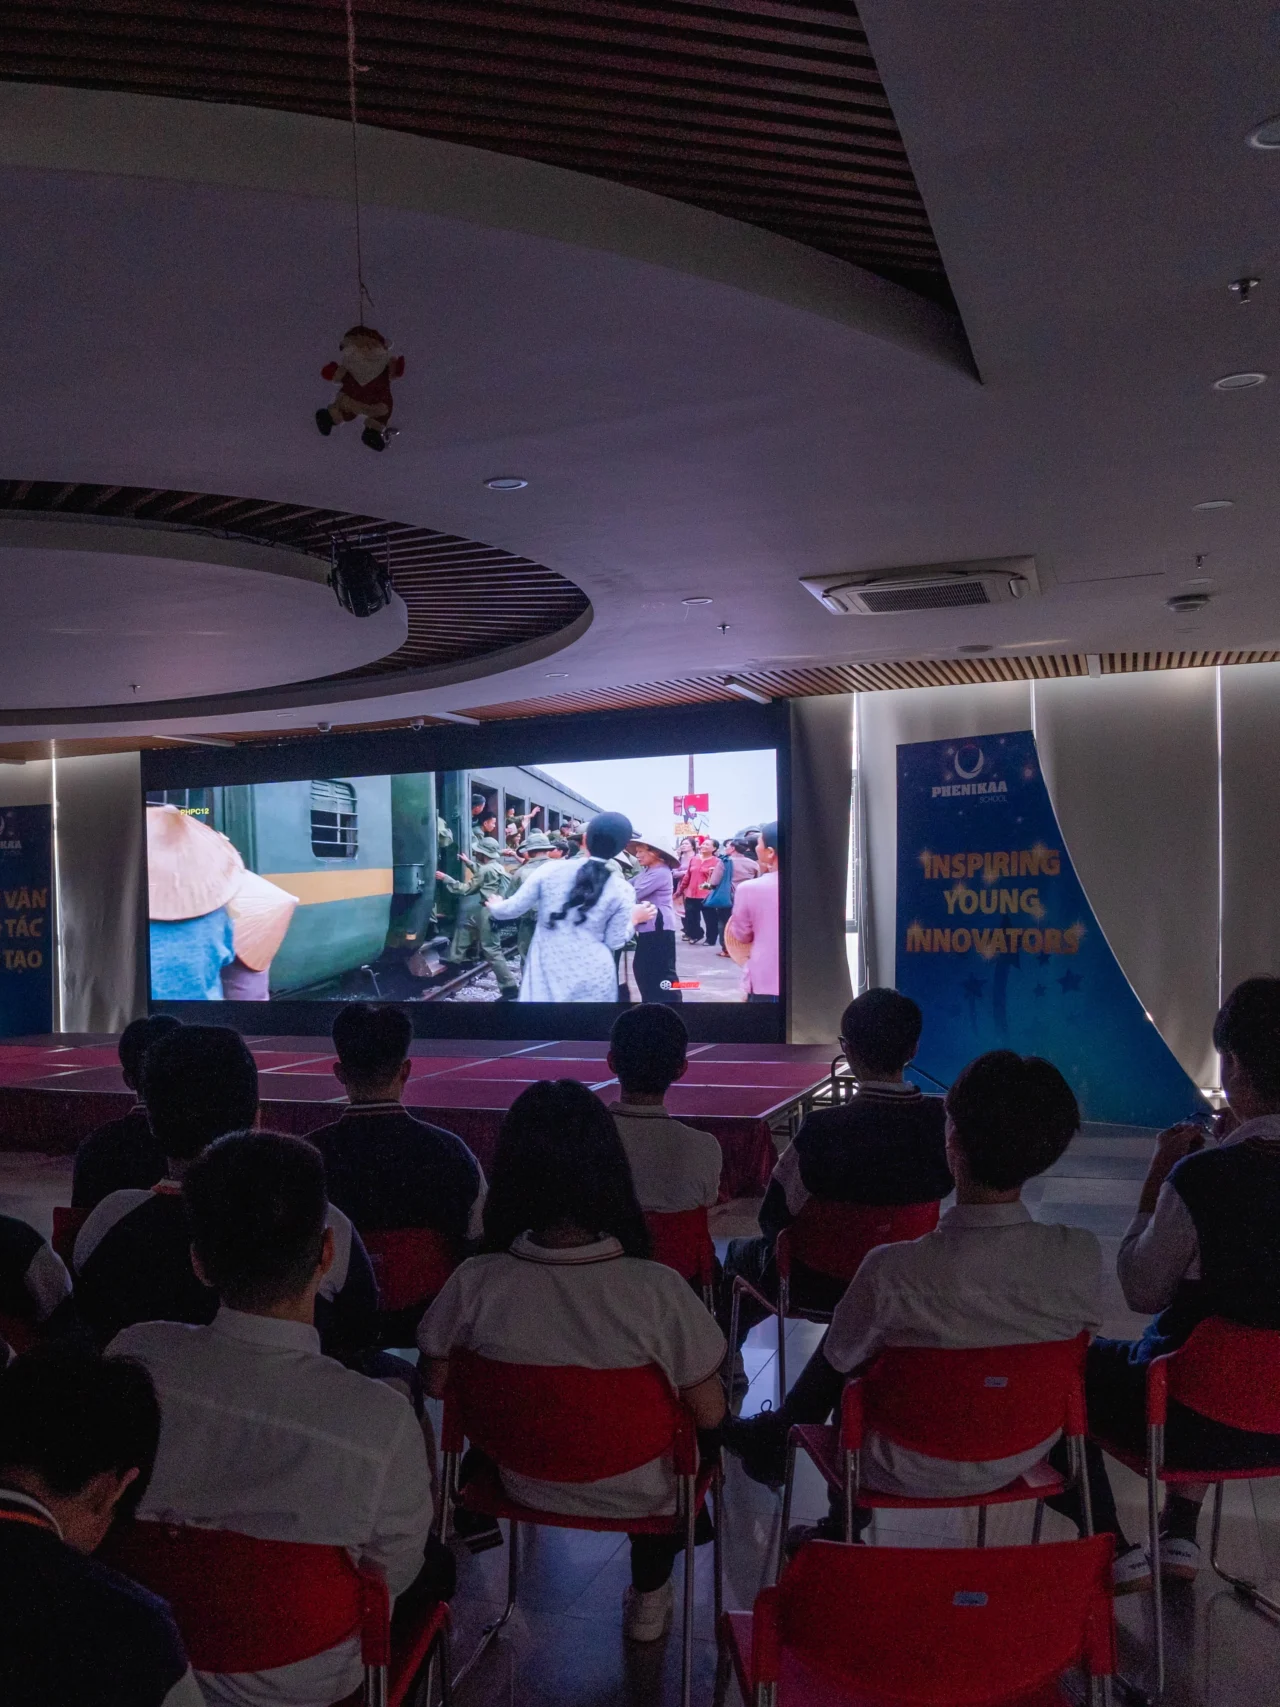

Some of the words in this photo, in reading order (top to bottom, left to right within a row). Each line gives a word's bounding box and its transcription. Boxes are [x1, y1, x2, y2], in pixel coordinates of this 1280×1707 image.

[931, 780, 1008, 798] PHENIKAA
[979, 795, 1007, 804] SCHOOL
[923, 850, 1061, 879] INSPIRING
[943, 887, 1042, 915] YOUNG
[906, 926, 1081, 954] INNOVATORS
